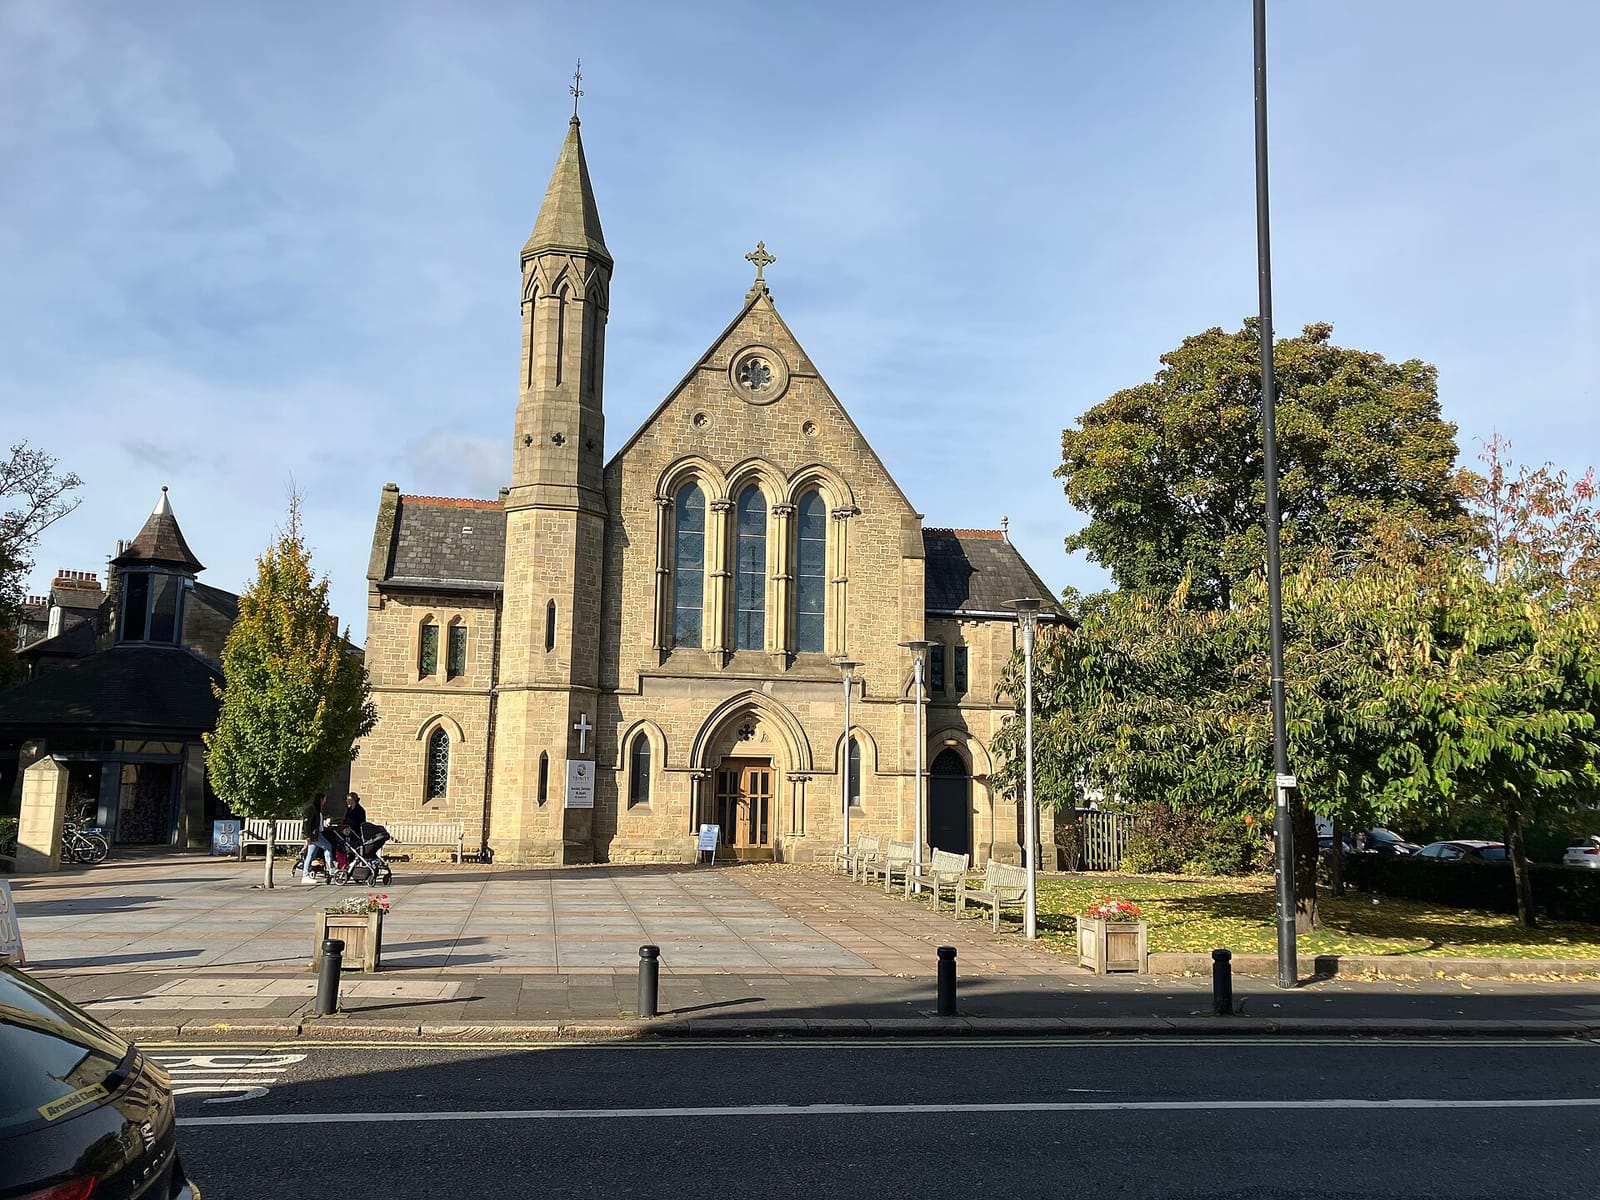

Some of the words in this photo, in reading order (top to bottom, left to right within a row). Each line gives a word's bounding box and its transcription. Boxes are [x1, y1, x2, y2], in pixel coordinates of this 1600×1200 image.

[220, 823, 234, 833] 19
[219, 834, 234, 845] 01
[47, 1094, 81, 1116] Arnold
